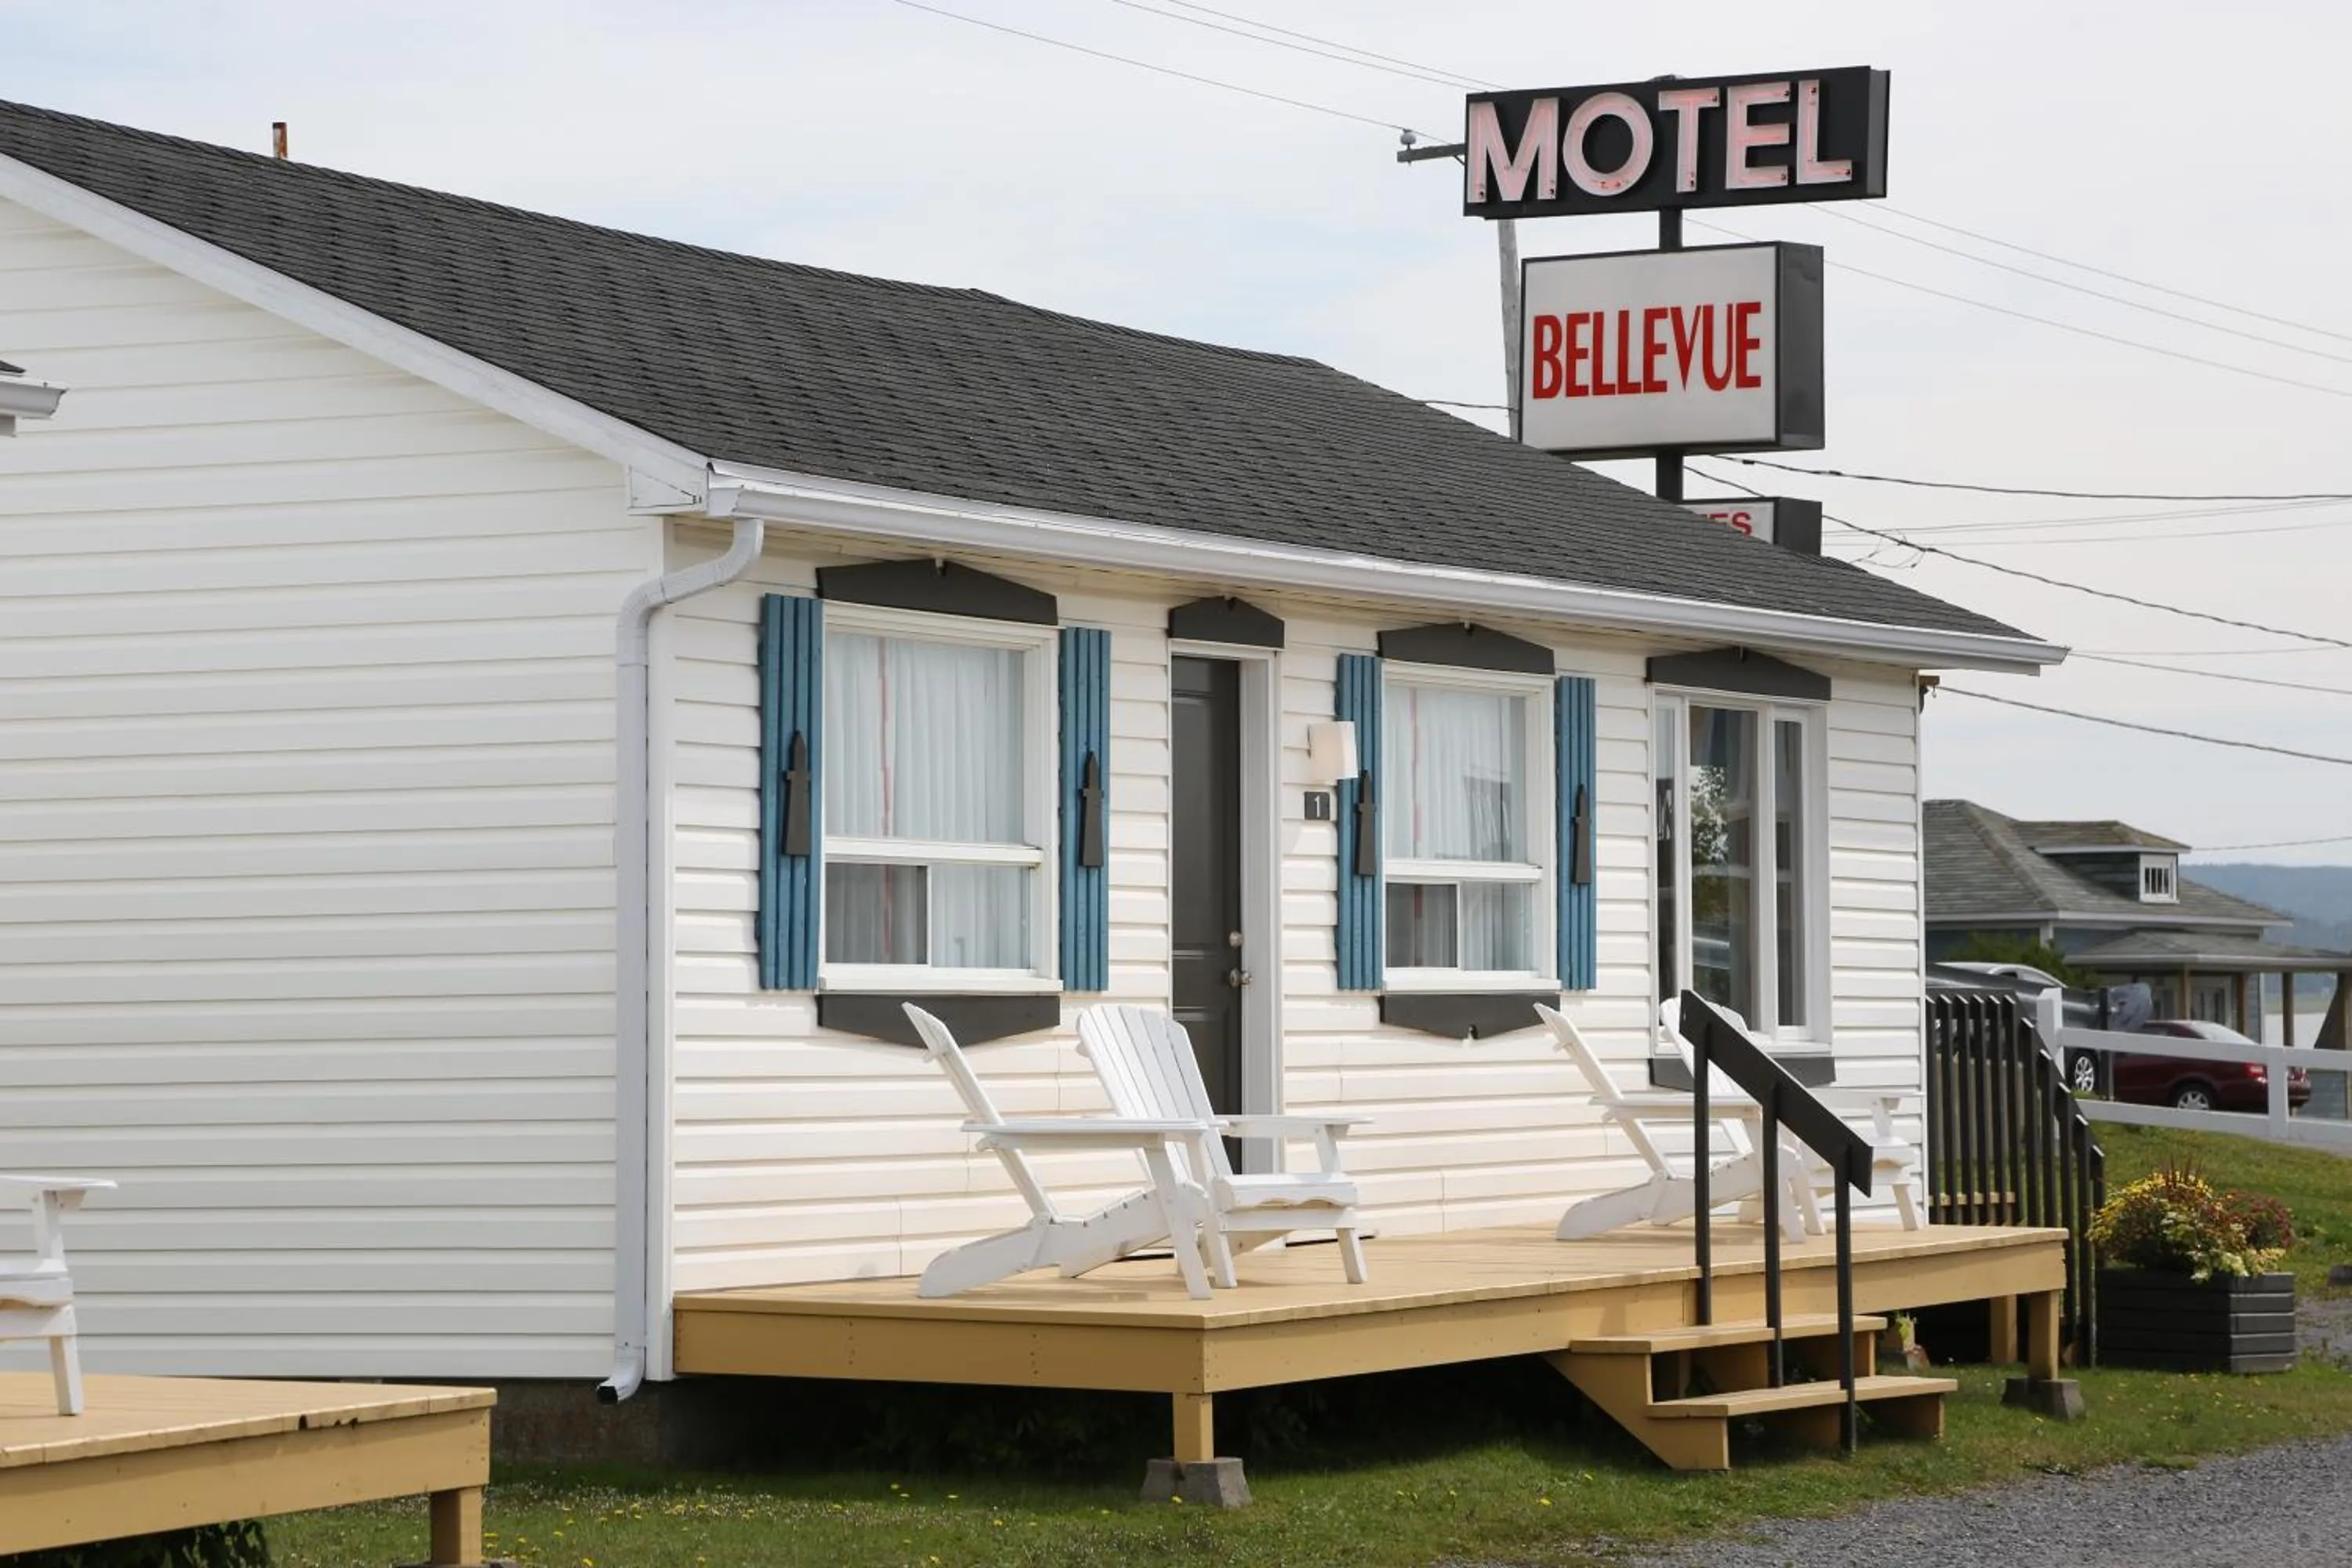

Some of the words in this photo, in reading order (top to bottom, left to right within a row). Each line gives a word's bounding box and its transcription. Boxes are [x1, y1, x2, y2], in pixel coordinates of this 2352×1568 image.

[1467, 79, 1853, 203] MOTEL
[1533, 301, 1762, 399] BELLEVUE
[1314, 795, 1321, 818] 1
